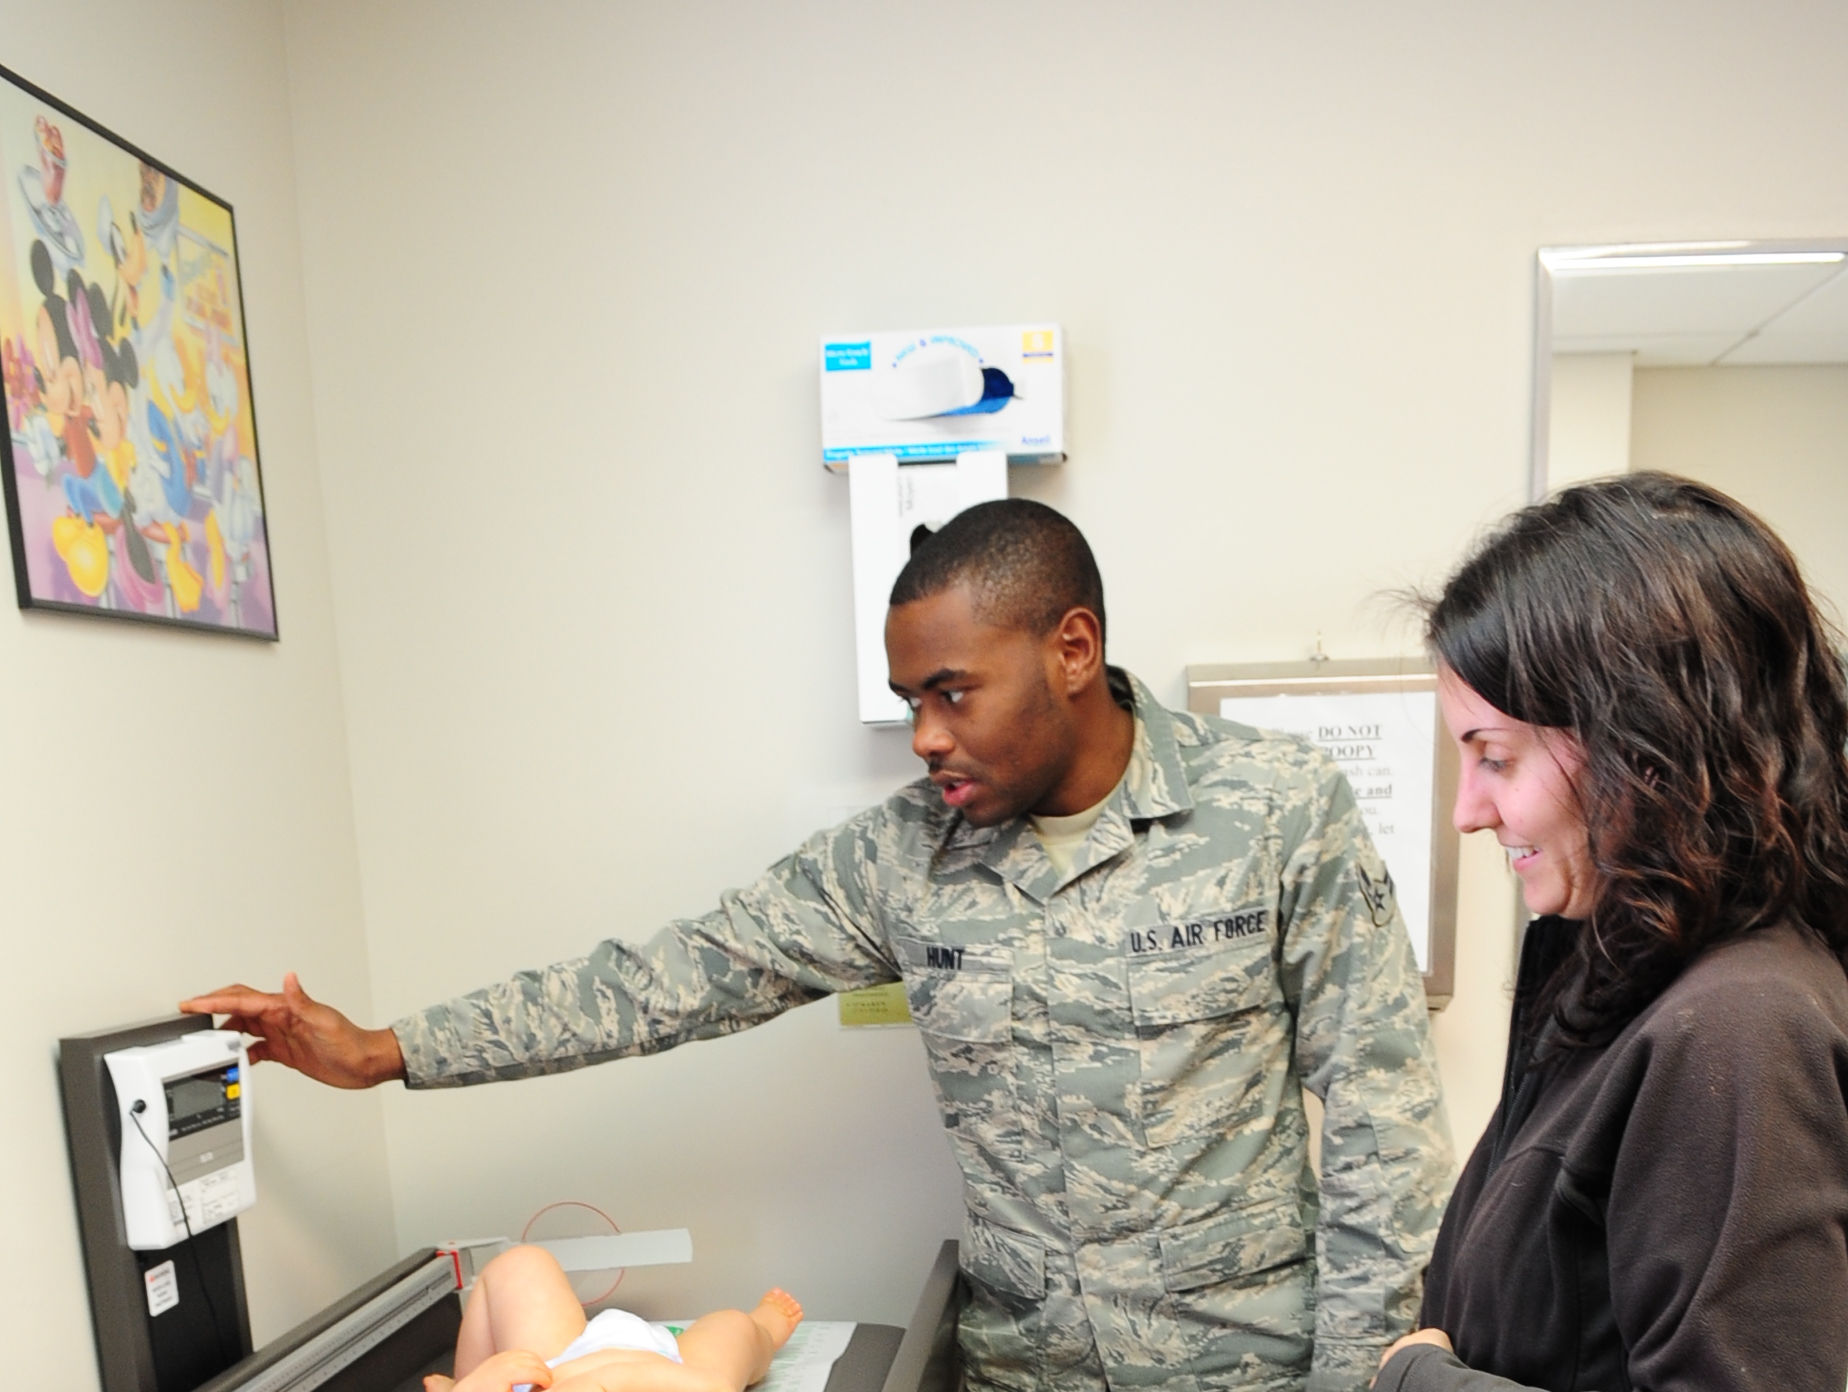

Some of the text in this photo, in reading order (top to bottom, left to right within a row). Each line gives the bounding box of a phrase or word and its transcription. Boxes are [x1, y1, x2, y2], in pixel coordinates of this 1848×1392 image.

[1318, 725, 1342, 738] DO
[1348, 724, 1381, 738] NOT
[1367, 784, 1392, 796] and
[1131, 910, 1266, 953] U.S. AIR FORCE
[926, 946, 965, 970] HUNT
